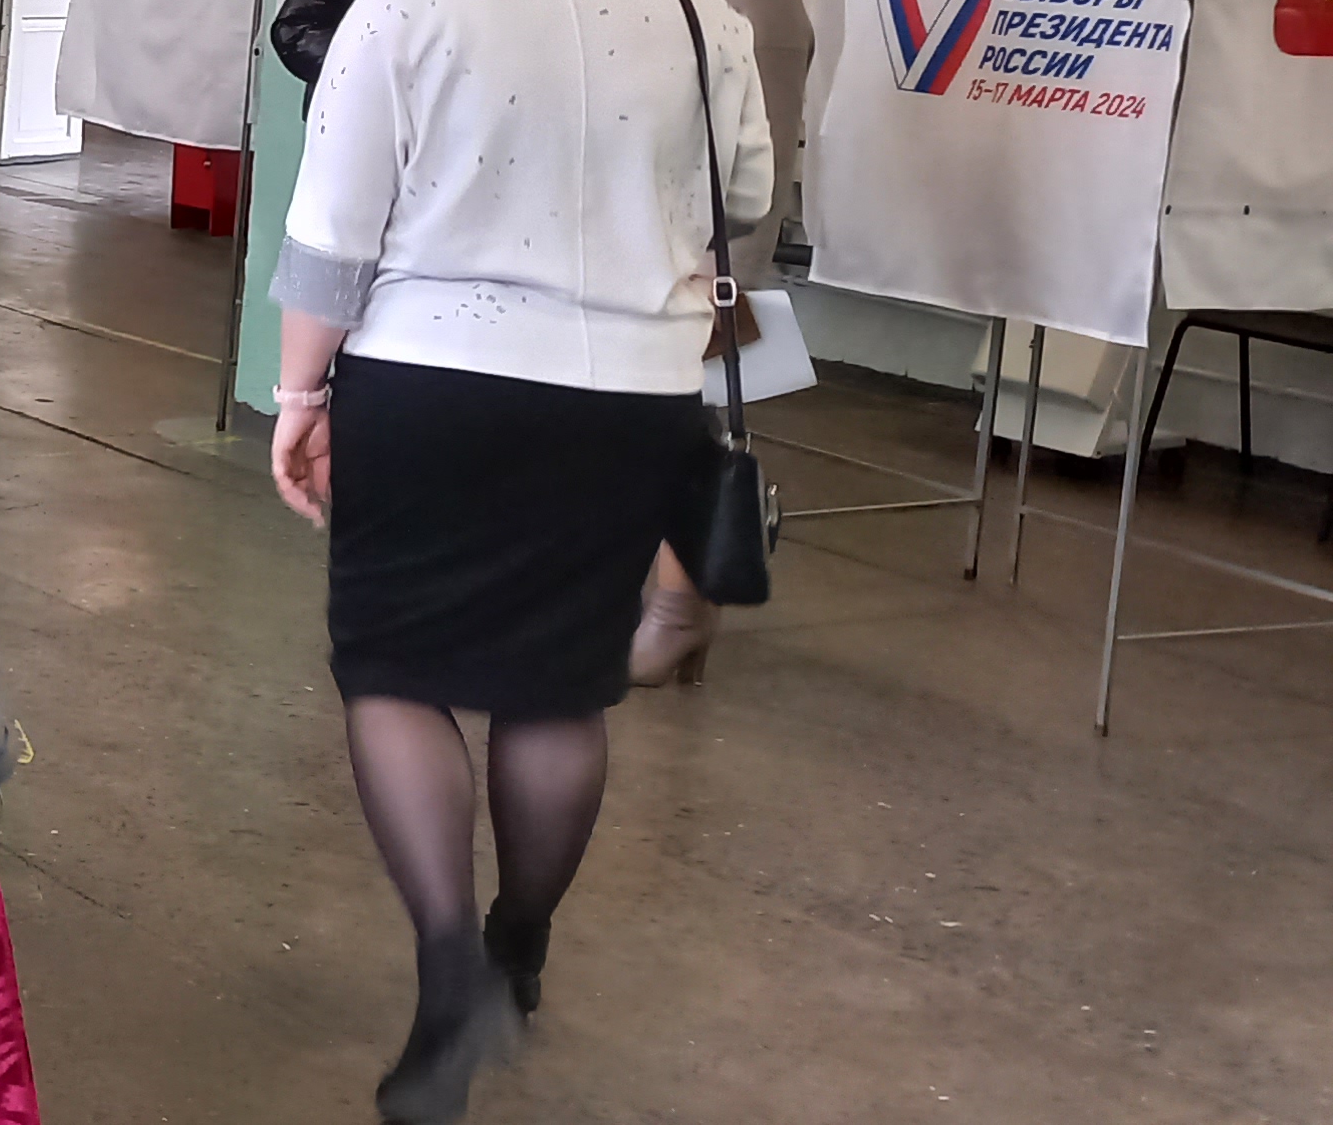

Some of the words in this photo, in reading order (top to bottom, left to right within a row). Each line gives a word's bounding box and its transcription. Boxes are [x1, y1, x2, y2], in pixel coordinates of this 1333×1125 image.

[991, 10, 1174, 52] ПРЕЗИДЕНТА
[979, 45, 1095, 80] РОССИИ
[1008, 84, 1090, 113] МАРТА
[1090, 92, 1147, 119] 2024
